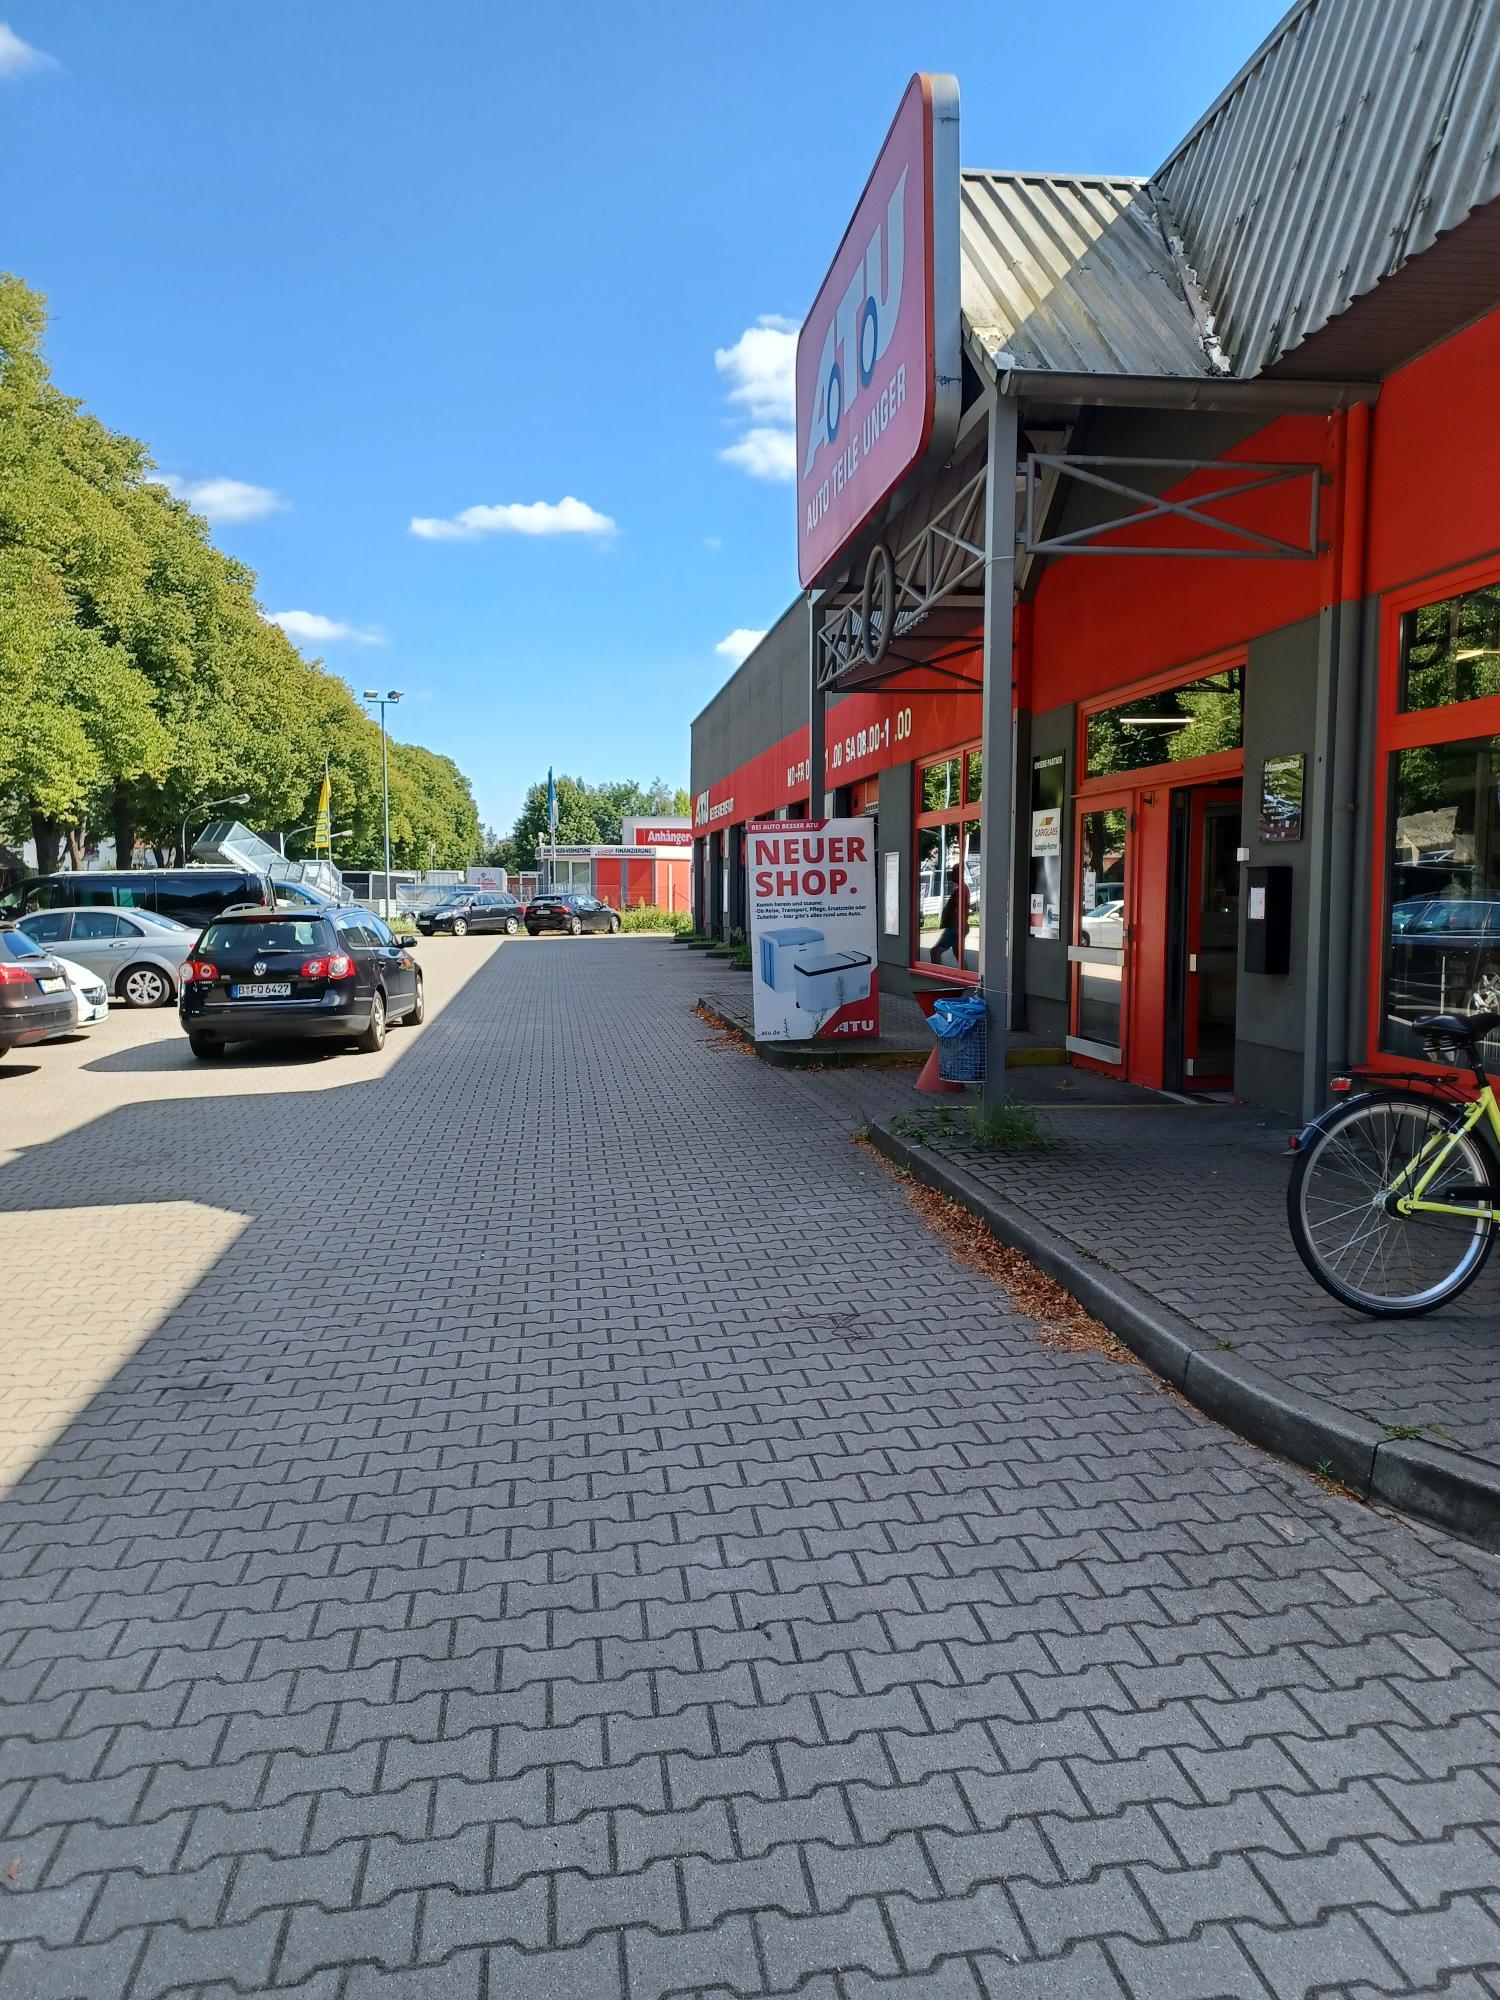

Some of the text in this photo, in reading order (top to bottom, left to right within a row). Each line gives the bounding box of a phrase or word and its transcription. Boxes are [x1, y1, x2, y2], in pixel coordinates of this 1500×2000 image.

[806, 362, 907, 537] AUTO TEILE UNGER
[1034, 826, 1058, 837] CARGLASS
[543, 847, 591, 855] ANHNGER-VERMIETUNG
[755, 836, 868, 866] NEUER
[755, 868, 858, 898] SHOP.
[238, 986, 245, 995] B
[265, 984, 289, 994] 6427
[833, 1020, 874, 1033] ATU
